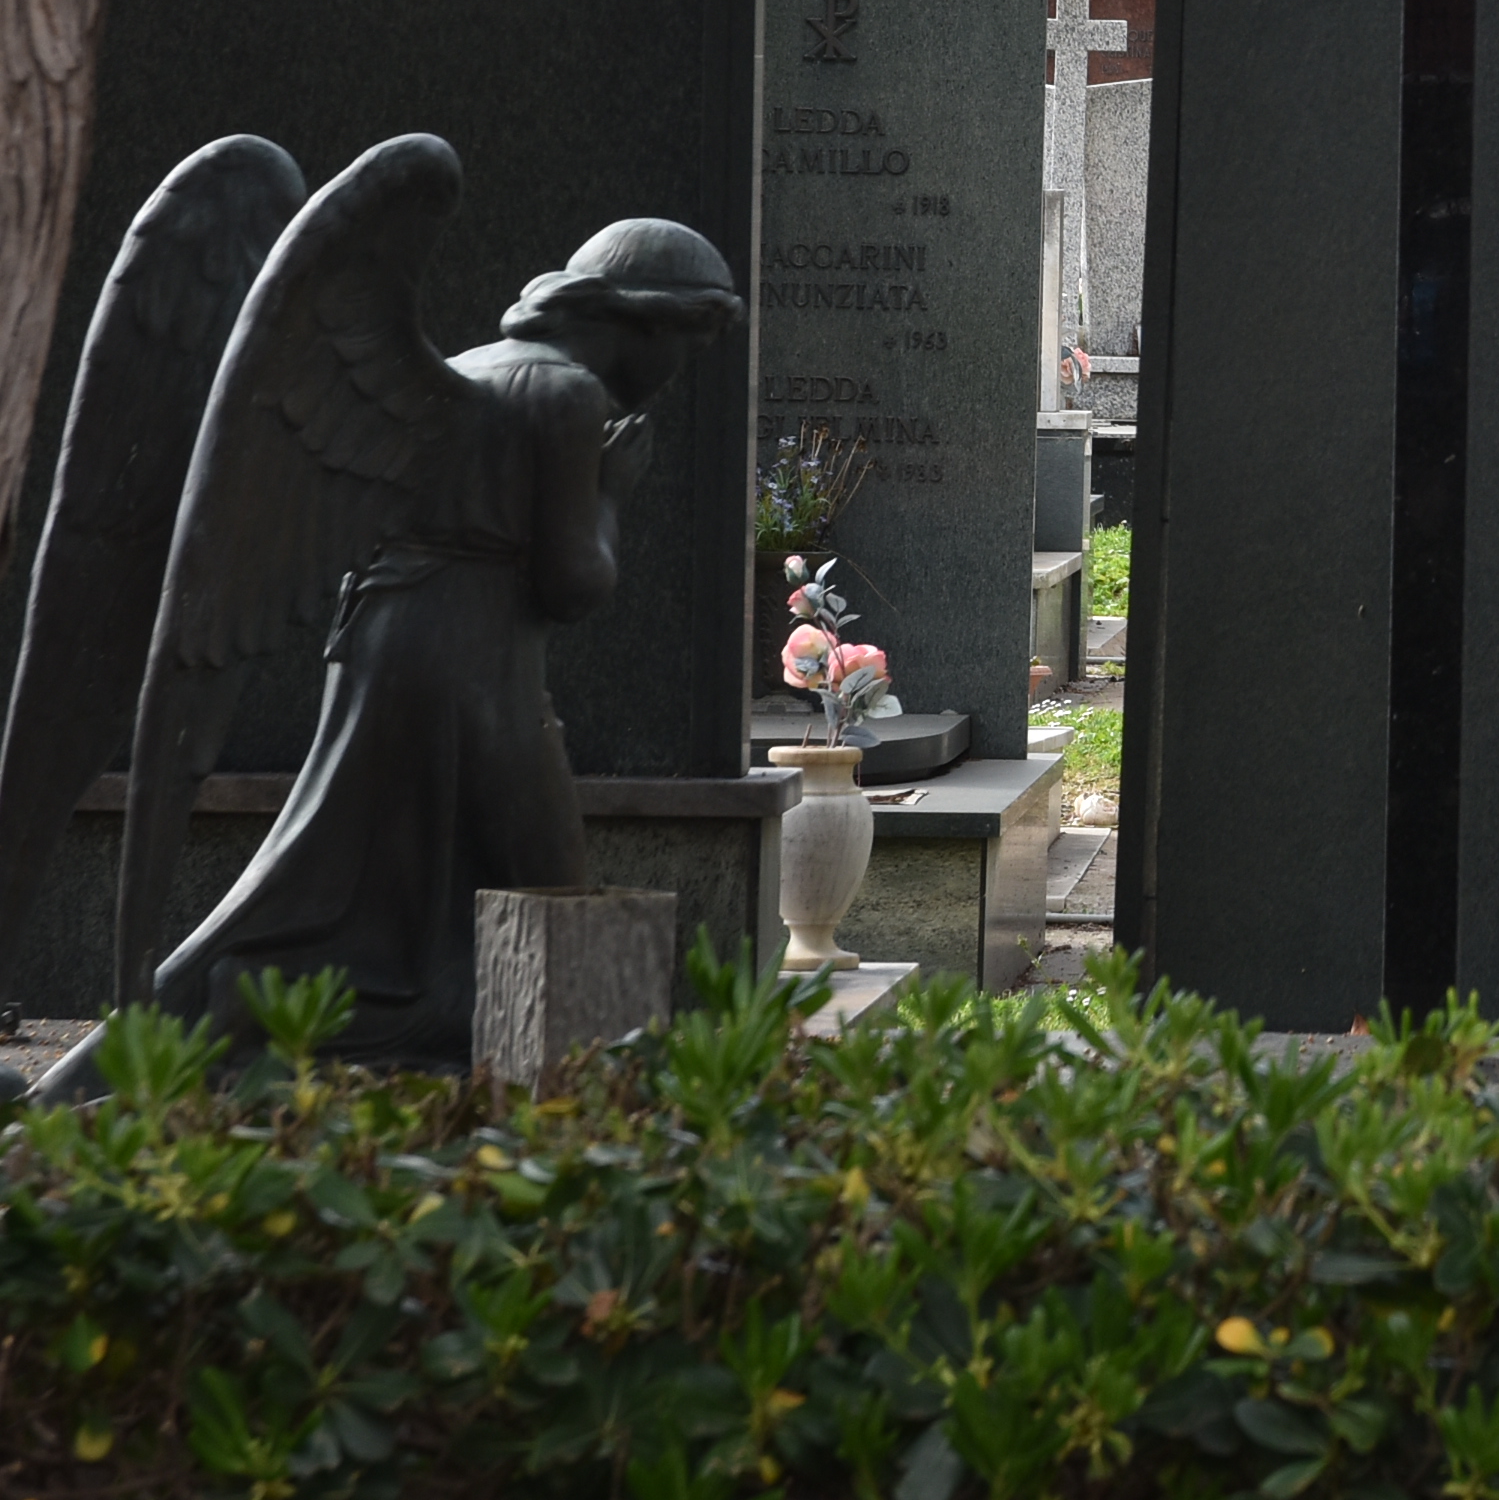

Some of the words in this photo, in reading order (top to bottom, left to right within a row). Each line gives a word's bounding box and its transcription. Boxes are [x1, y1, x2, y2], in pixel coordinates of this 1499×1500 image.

[773, 106, 886, 137] LEDDA
[913, 194, 950, 217] 1918
[905, 331, 948, 351] 1963
[765, 377, 880, 405] LEDDA
